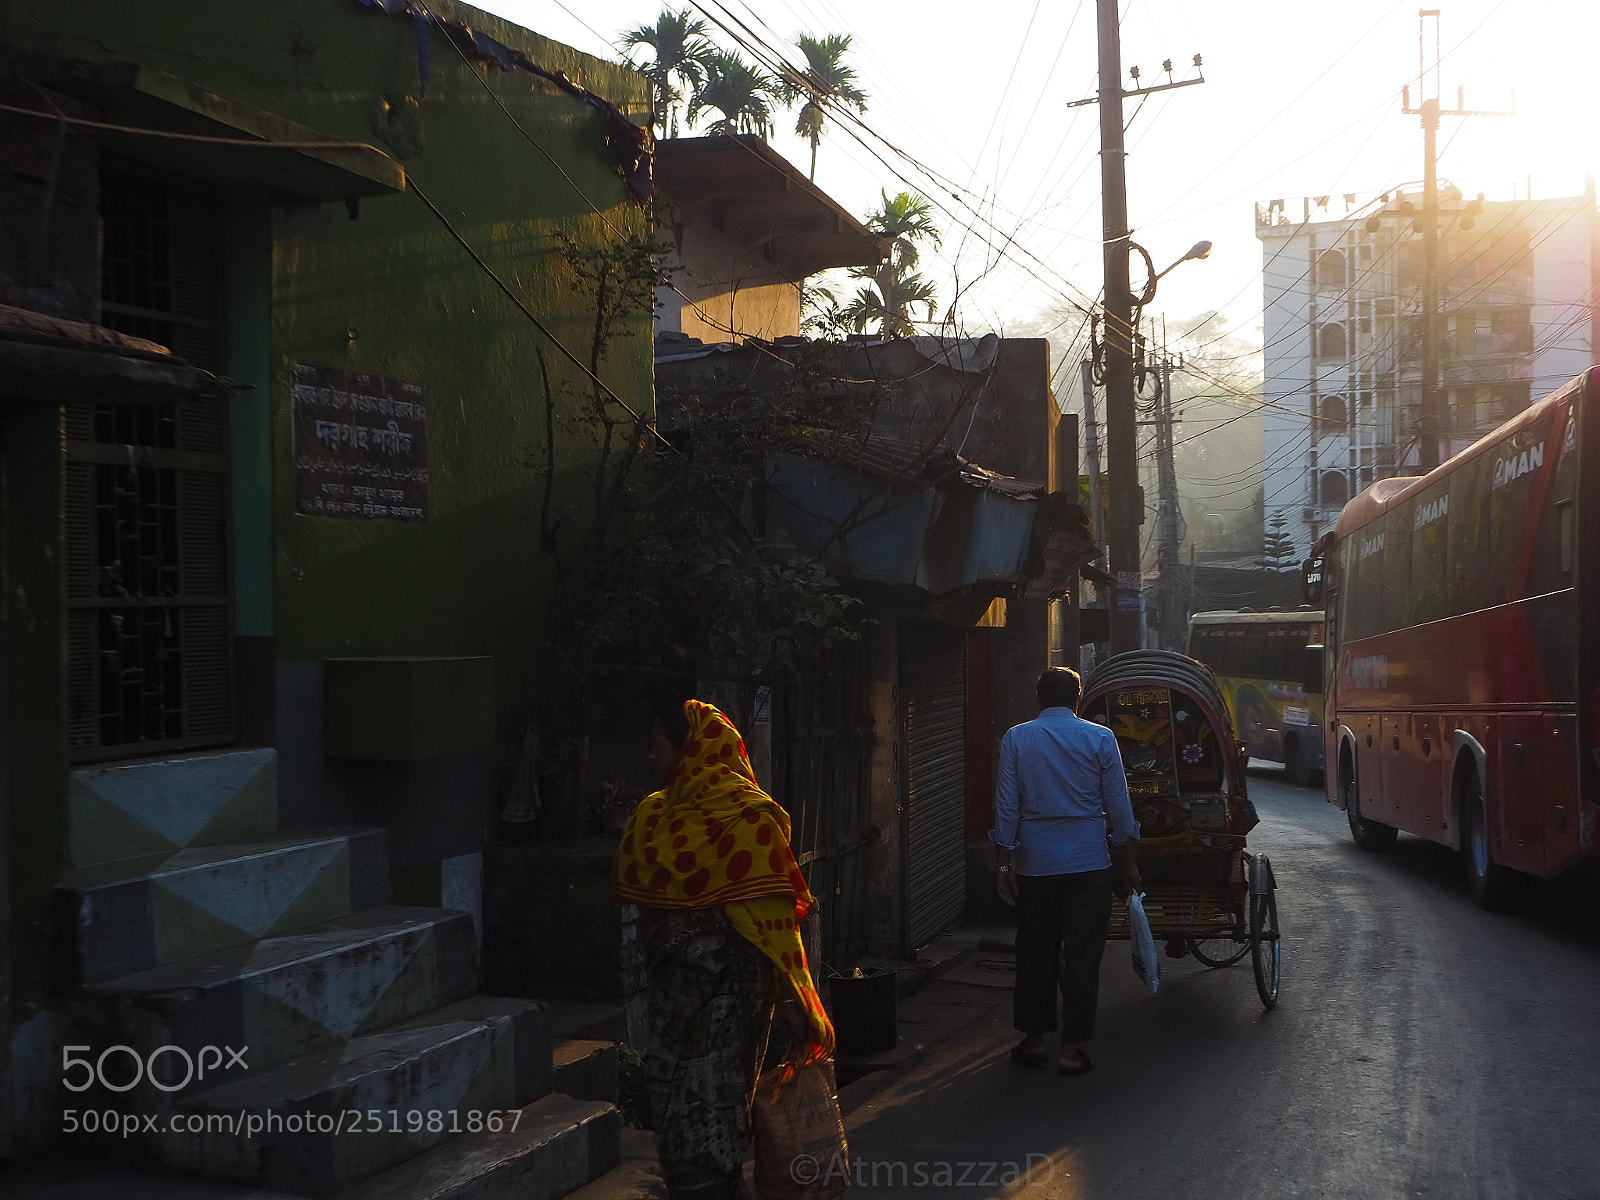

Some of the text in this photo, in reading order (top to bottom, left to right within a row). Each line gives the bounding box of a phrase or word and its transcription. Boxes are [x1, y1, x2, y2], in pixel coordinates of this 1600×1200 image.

[315, 419, 369, 451] দরগাহ
[1504, 441, 1544, 484] MAN
[1422, 494, 1449, 526] MAN
[1365, 532, 1385, 558] MAN
